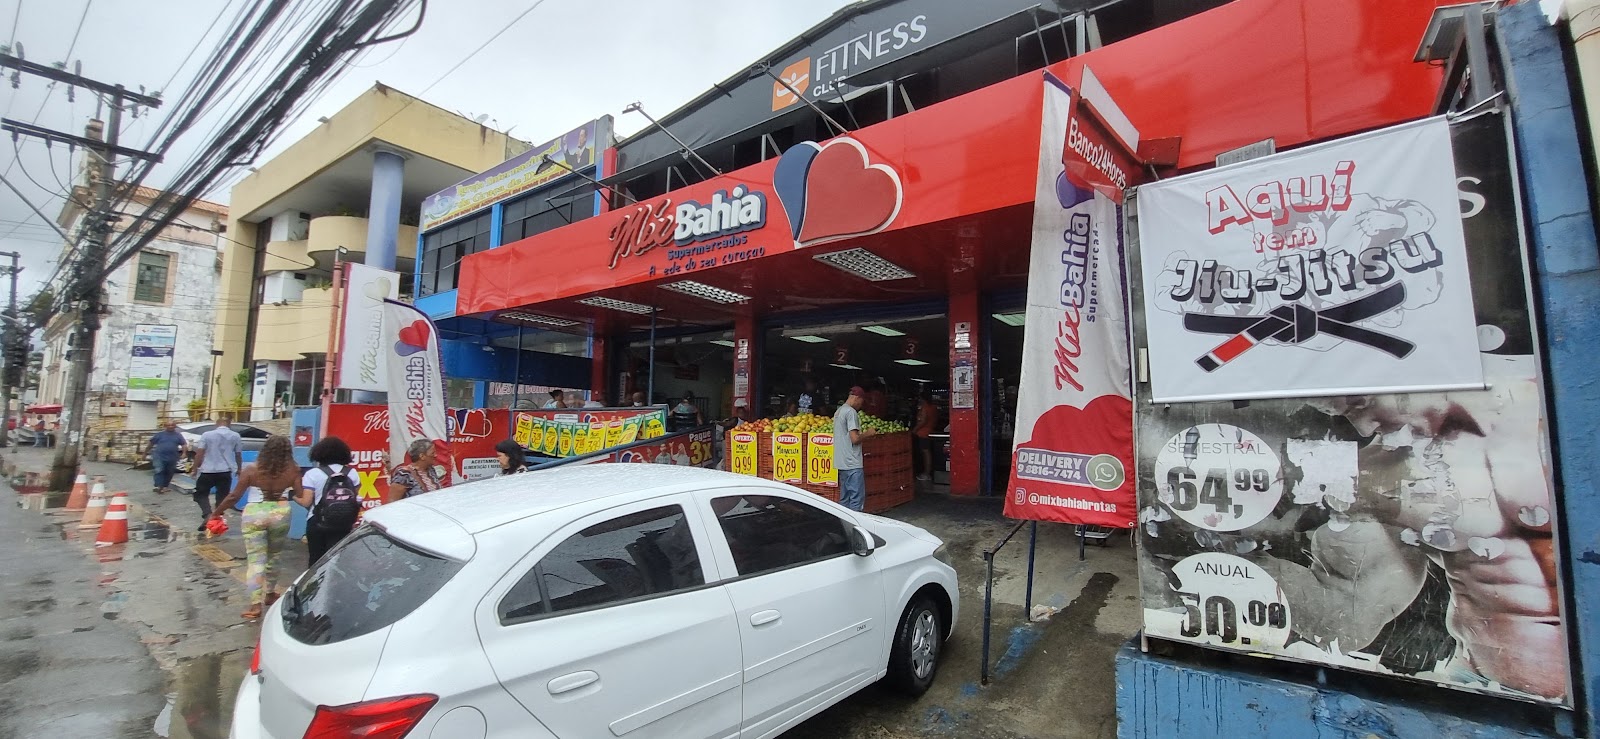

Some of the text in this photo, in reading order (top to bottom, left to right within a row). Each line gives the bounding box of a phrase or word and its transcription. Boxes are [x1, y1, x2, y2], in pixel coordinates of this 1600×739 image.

[816, 15, 927, 81] FITNESS
[1068, 117, 1127, 191] Banco24Horas
[1206, 161, 1356, 234] Aqui
[1253, 226, 1318, 253] tem
[650, 266, 656, 277] A
[686, 258, 696, 270] do
[701, 256, 717, 268] seu
[1086, 222, 1099, 323] Supermercad
[1170, 232, 1445, 301] Jiu-Jitsu
[838, 351, 846, 362] 2
[906, 343, 915, 355] 3
[690, 430, 711, 442] Pague
[735, 435, 754, 443] OFERTA
[349, 450, 383, 466] gue
[1167, 442, 1267, 455] SEESTRAL
[1019, 451, 1083, 470] DELIVERY
[358, 470, 382, 499] X
[361, 500, 382, 509] ros
[1028, 492, 1118, 513] @mixbahiabrotas
[1194, 562, 1255, 580] ANUAL
